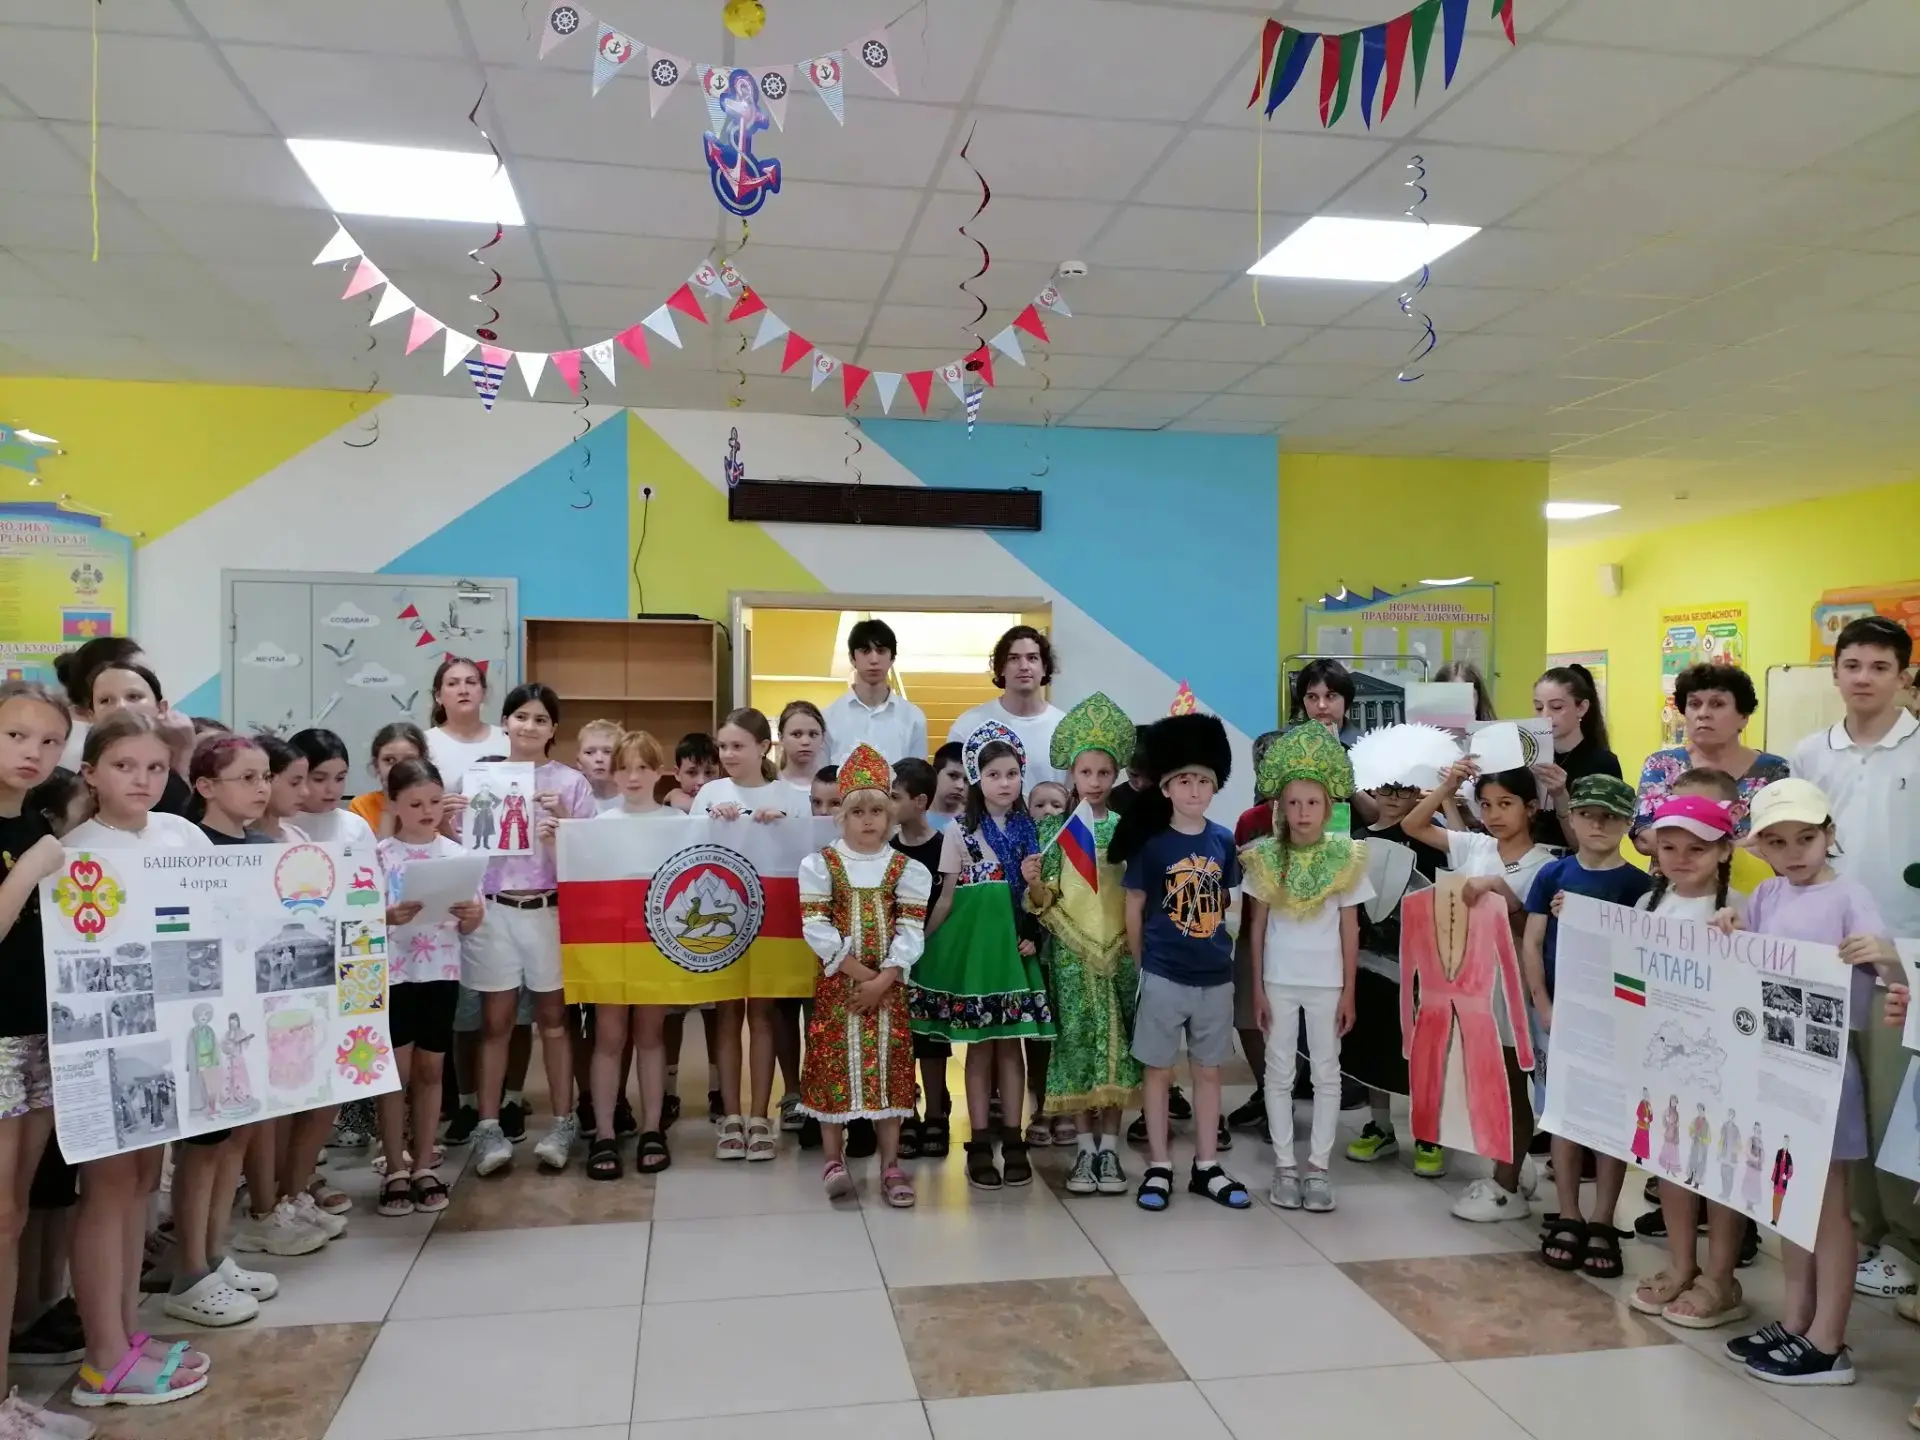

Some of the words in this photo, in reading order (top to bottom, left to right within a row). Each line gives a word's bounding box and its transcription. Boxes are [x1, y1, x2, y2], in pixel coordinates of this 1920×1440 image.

[53, 535, 87, 544] КРАЯ
[1361, 611, 1418, 621] ПРАВОВЫЕ
[1423, 613, 1490, 623] ДОКУМЕНТЫ
[143, 855, 262, 869] БАШКОРТОСТАН
[179, 876, 187, 889] 4
[191, 878, 228, 892] отряд
[683, 951, 708, 963] NORTH
[1707, 927, 1796, 976] РОССИИ
[1636, 946, 1712, 991] ТАТАРЫ
